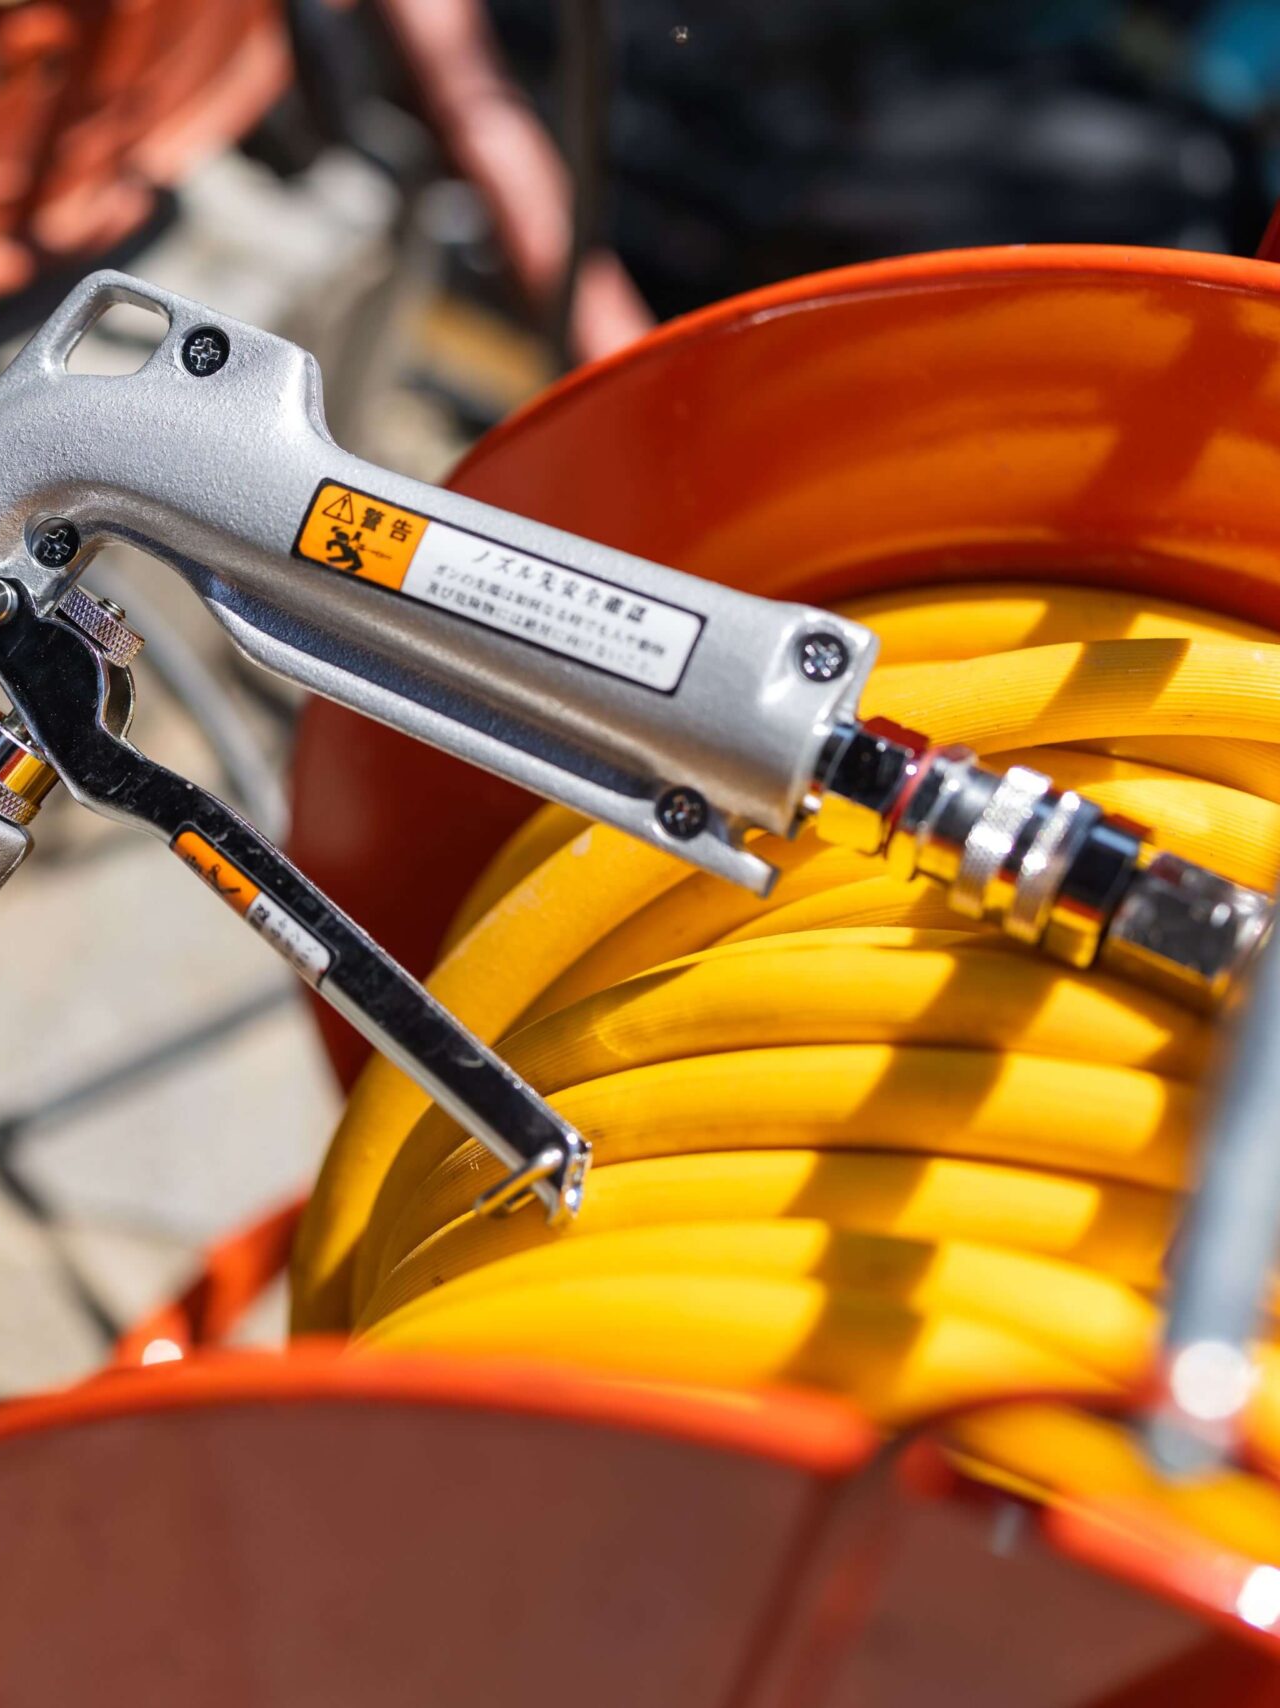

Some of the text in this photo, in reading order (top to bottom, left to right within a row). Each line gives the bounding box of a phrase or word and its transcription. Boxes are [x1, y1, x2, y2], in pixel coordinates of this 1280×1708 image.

[360, 507, 412, 543] 警告
[472, 550, 646, 622] ノズル先安全確認
